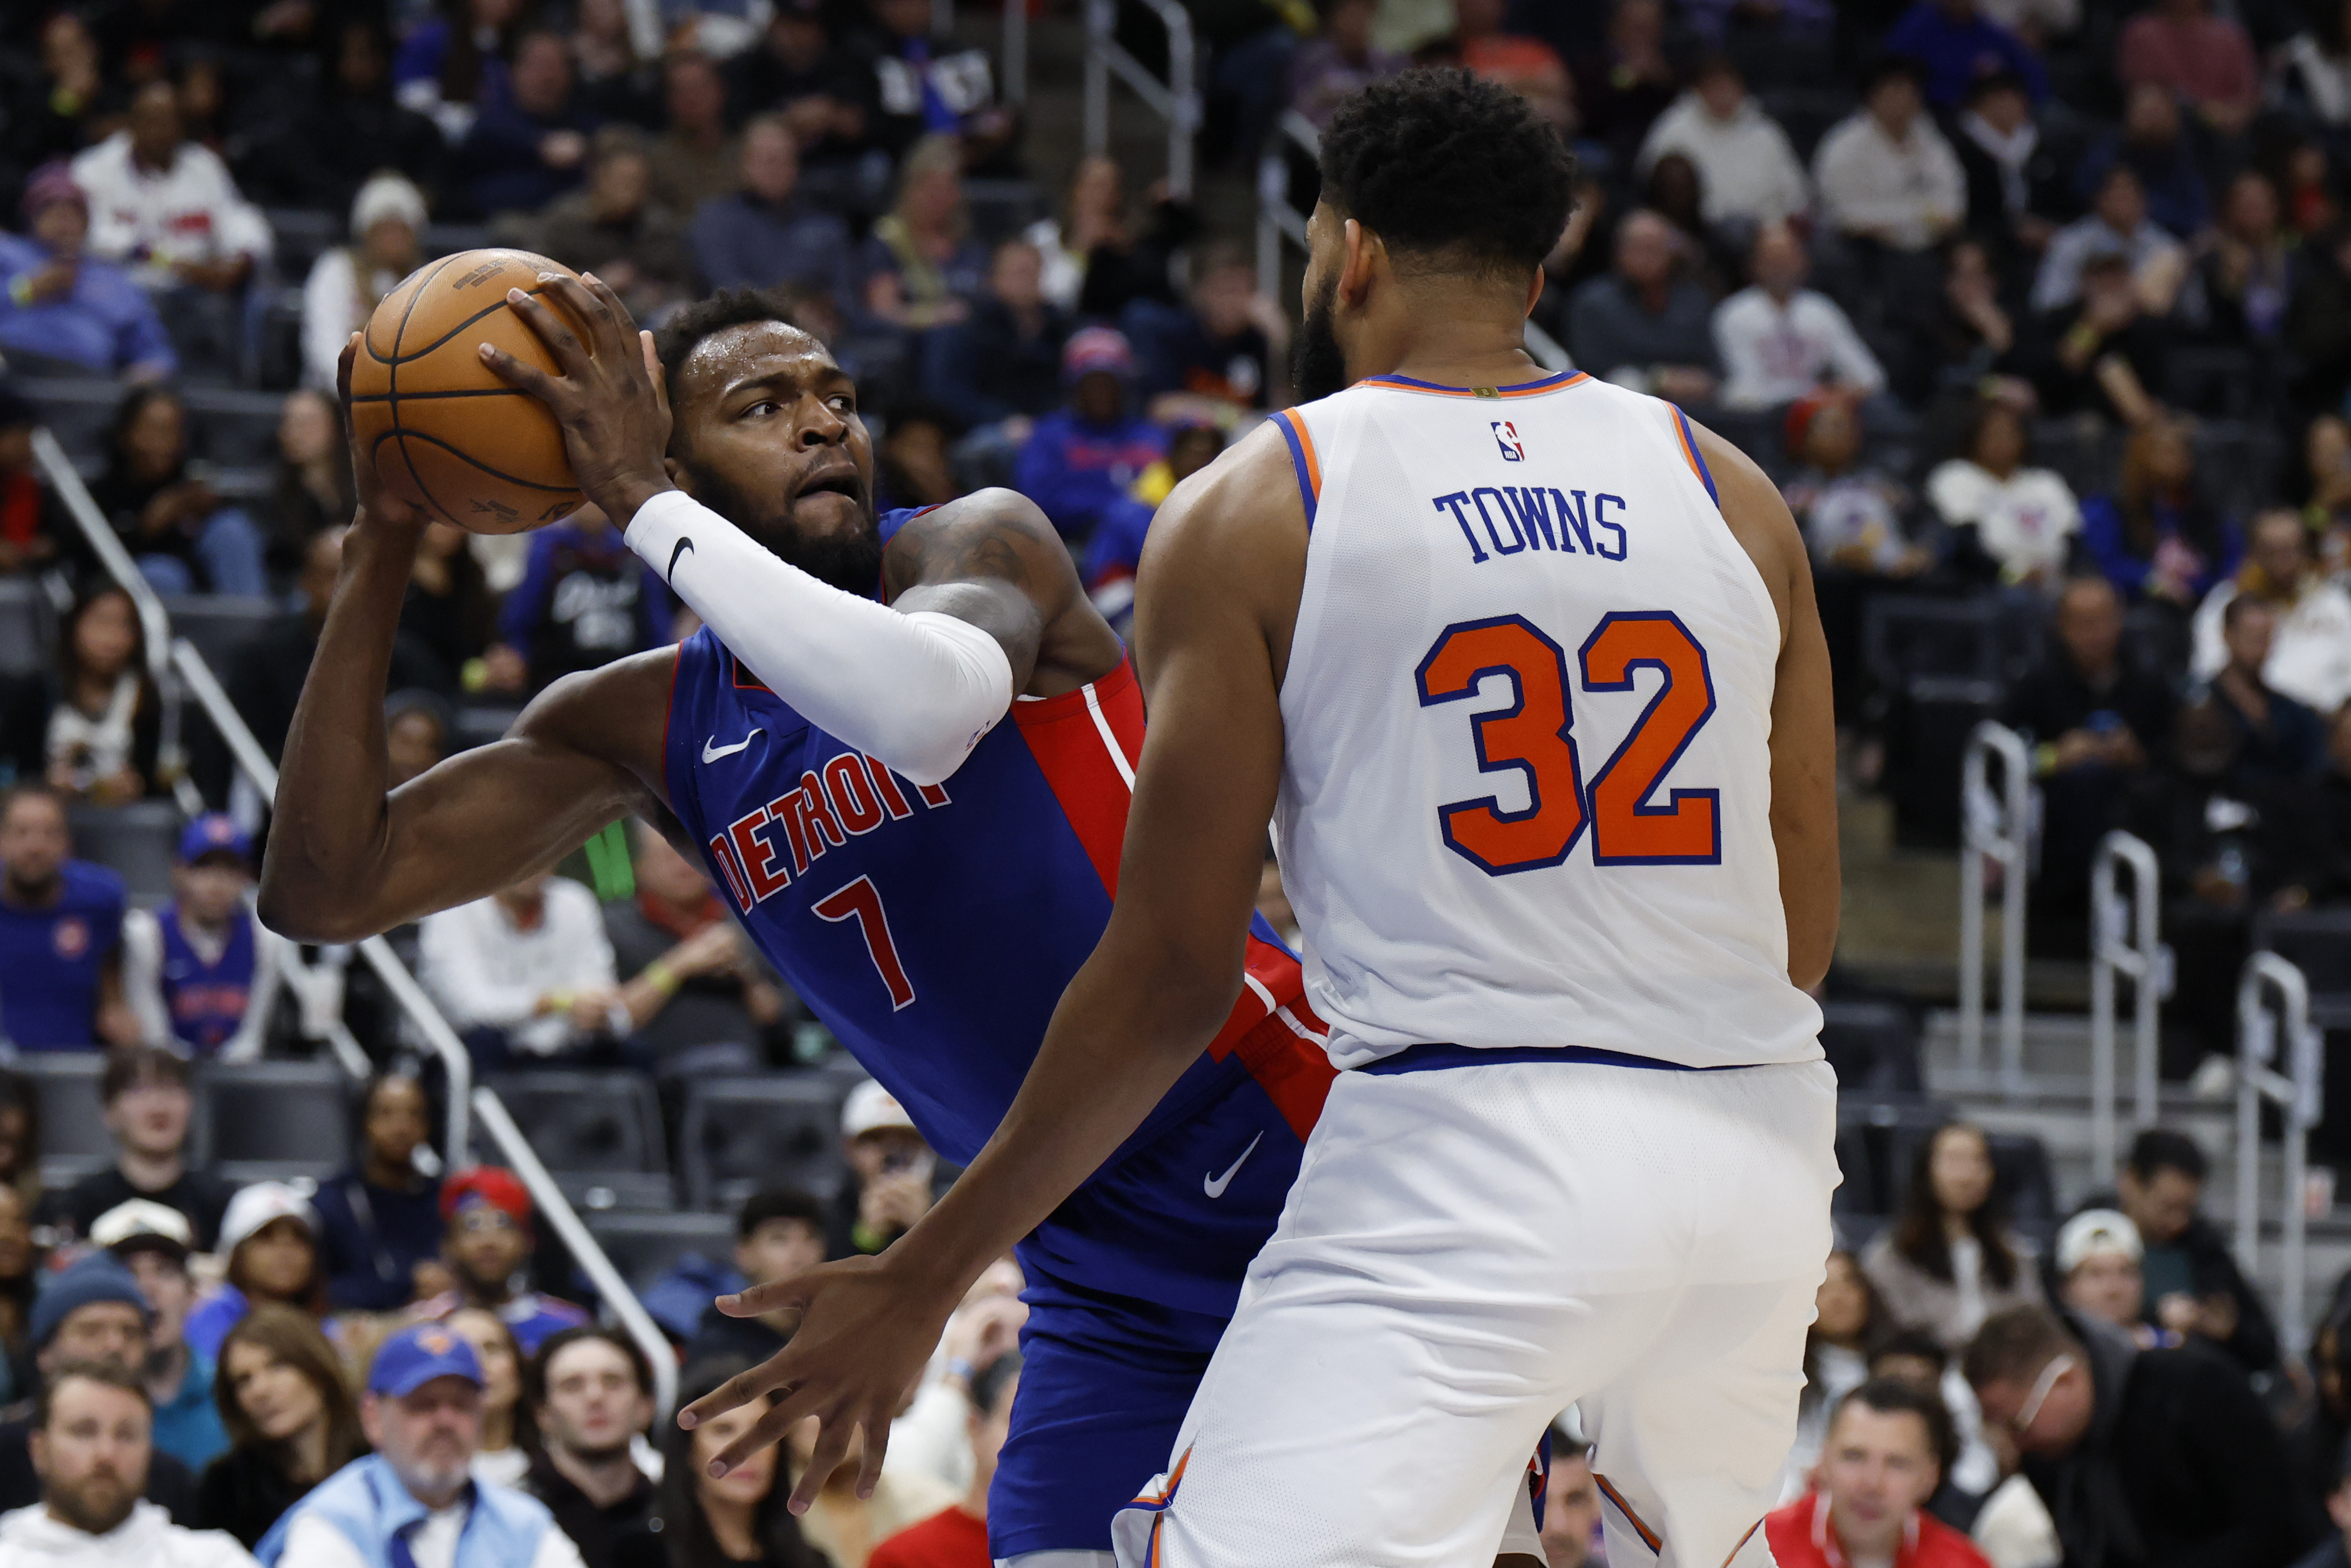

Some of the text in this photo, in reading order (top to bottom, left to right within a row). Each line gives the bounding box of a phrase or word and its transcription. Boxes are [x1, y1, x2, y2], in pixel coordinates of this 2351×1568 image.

[1504, 451, 1518, 459] NBA
[1432, 486, 1627, 564] TOWNS
[1414, 611, 1721, 876] 32
[811, 874, 916, 1012] 7
